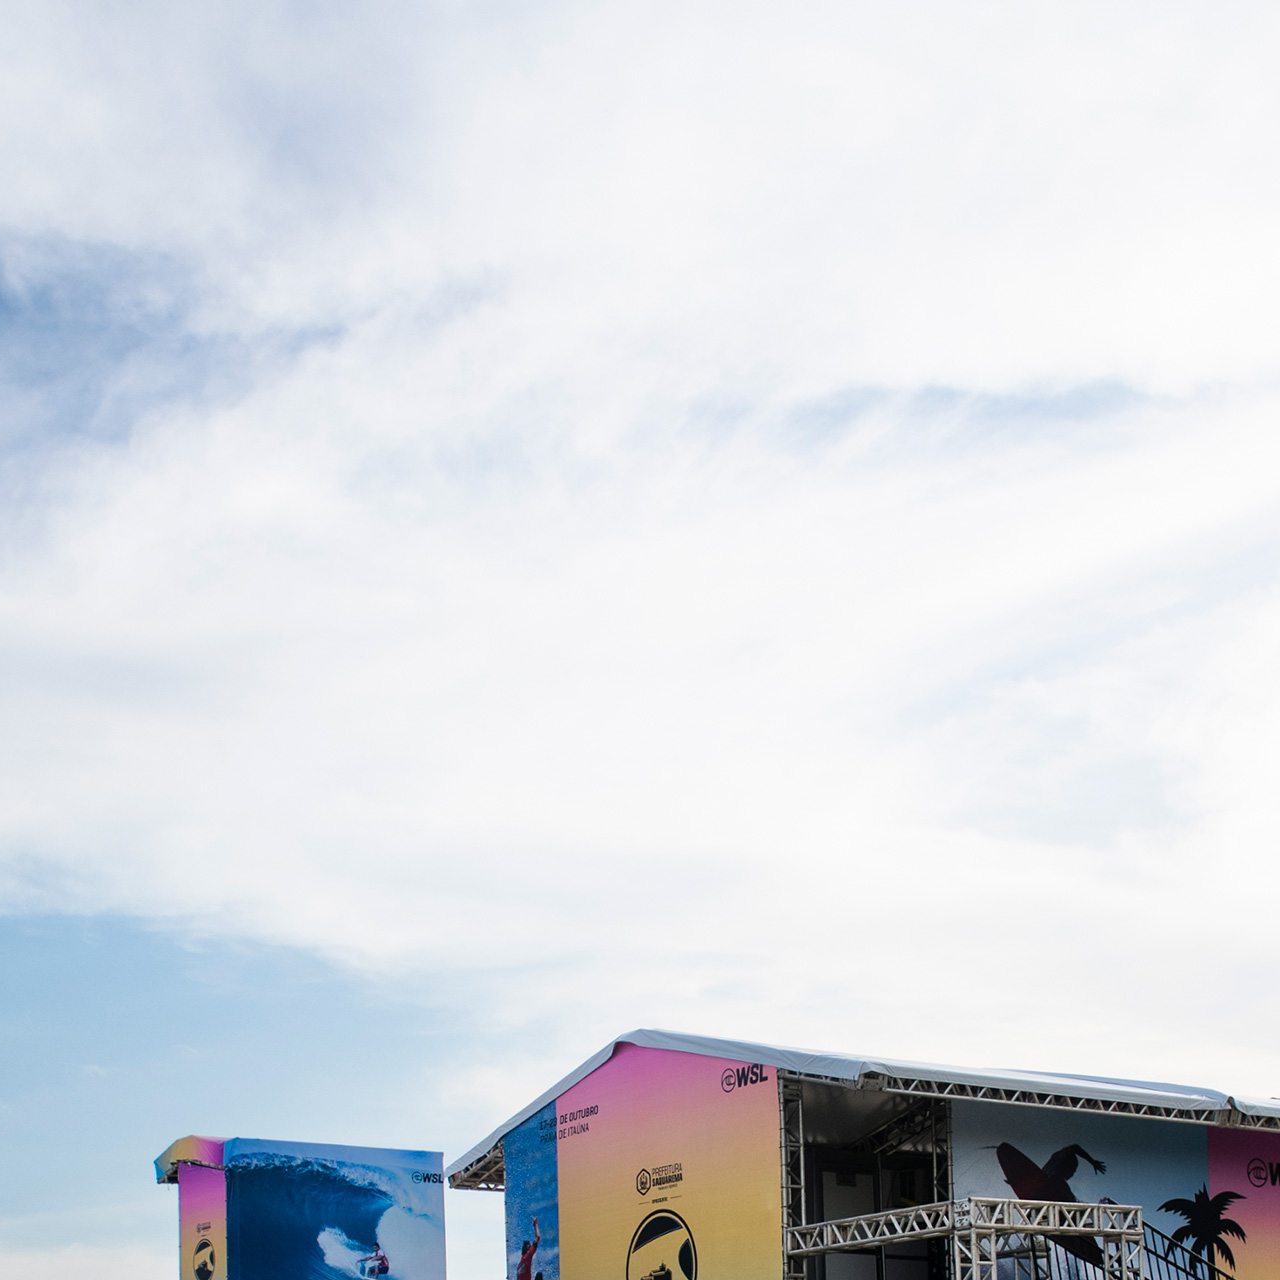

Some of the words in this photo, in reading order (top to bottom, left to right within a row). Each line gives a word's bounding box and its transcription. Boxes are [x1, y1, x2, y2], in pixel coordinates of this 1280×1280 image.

[736, 1064, 769, 1088] WSL
[560, 1114, 568, 1125] DE
[569, 1105, 599, 1121] OUTUBRO
[558, 1128, 568, 1140] DE
[652, 1163, 683, 1177] PREFEITURA
[422, 1172, 444, 1184] WSL
[652, 1173, 683, 1187] SAQUAREMA
